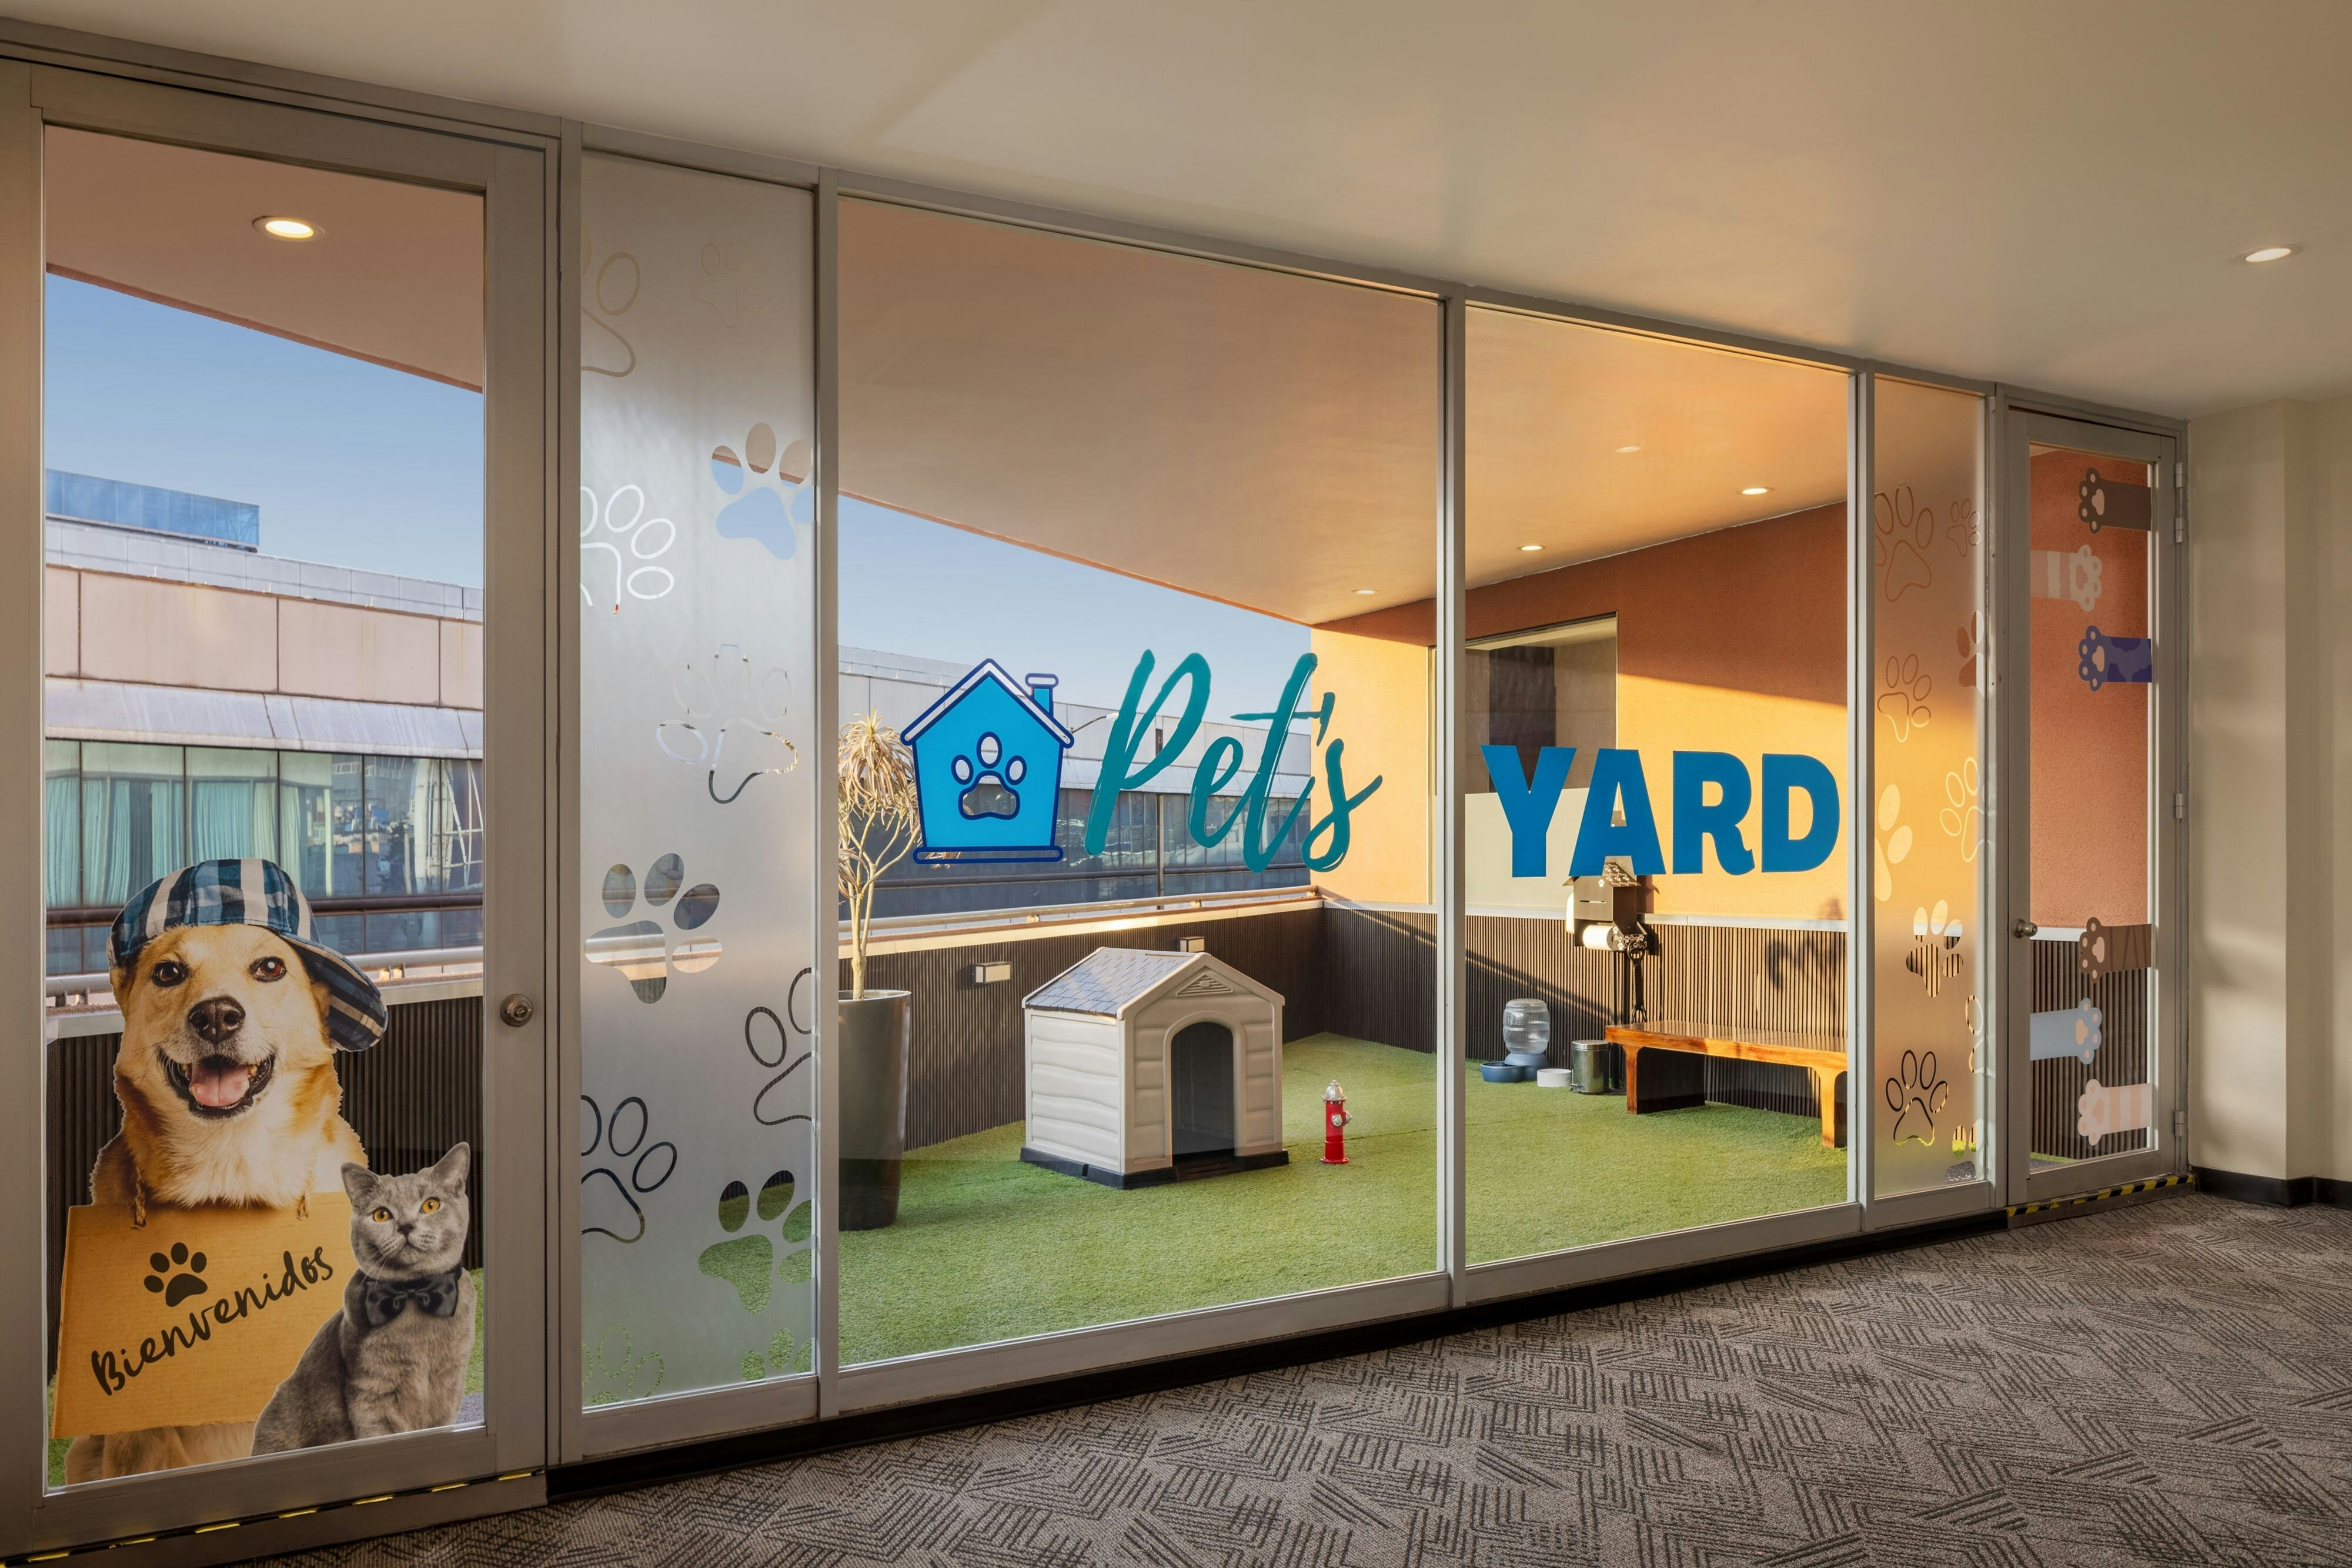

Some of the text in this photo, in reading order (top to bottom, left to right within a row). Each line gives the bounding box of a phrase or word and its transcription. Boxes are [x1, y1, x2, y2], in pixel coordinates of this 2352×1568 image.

[1084, 648, 1840, 877] Pet's YARD
[91, 1245, 333, 1396] Bienvenidos
